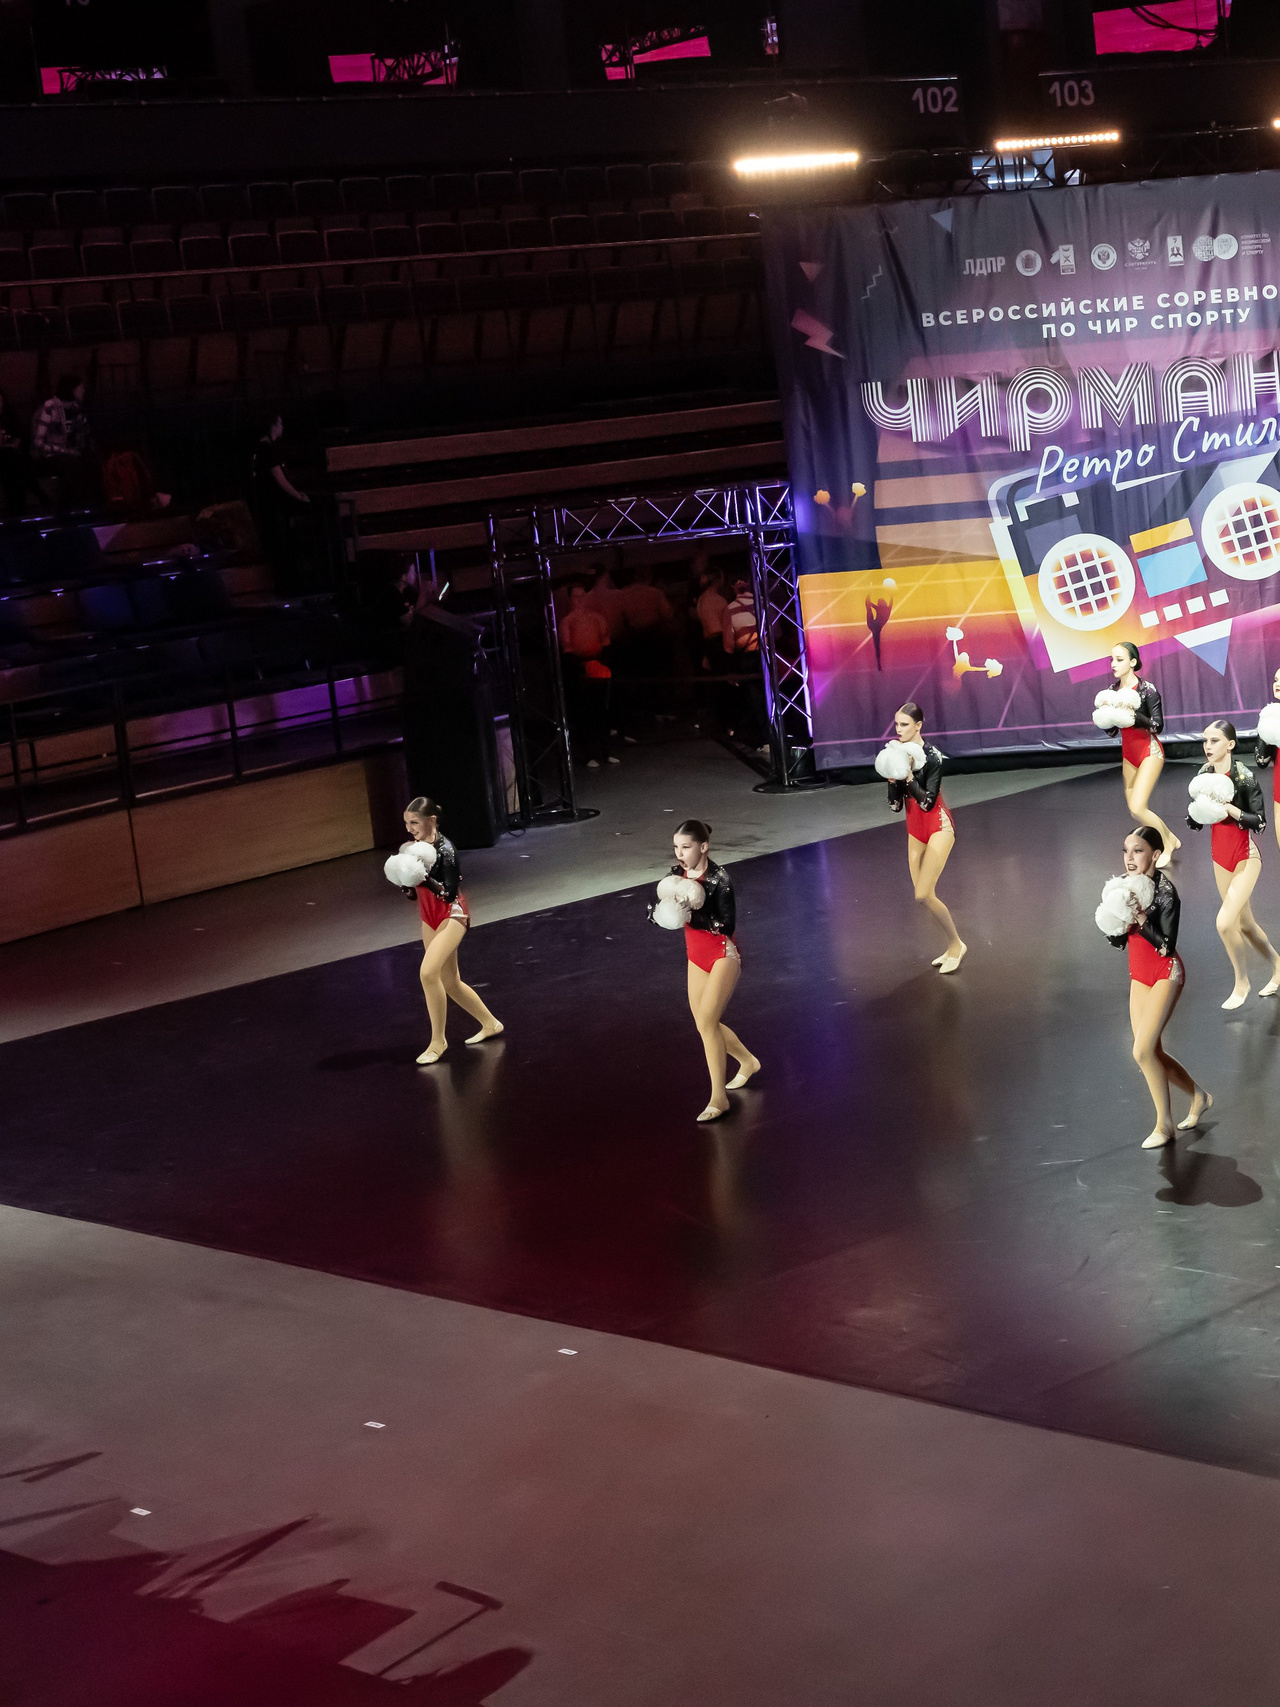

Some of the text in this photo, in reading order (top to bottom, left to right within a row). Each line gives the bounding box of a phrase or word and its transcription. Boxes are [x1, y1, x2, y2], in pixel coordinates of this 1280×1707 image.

[911, 87, 959, 114] 102
[1048, 80, 1095, 107] 103
[963, 256, 1006, 277] ЛДПР
[922, 295, 1146, 328] ВСЕРОССИЙСКИЕ
[1042, 307, 1252, 339] ПО ЧИР СПОРТУ
[1035, 444, 1156, 494] Ретро
